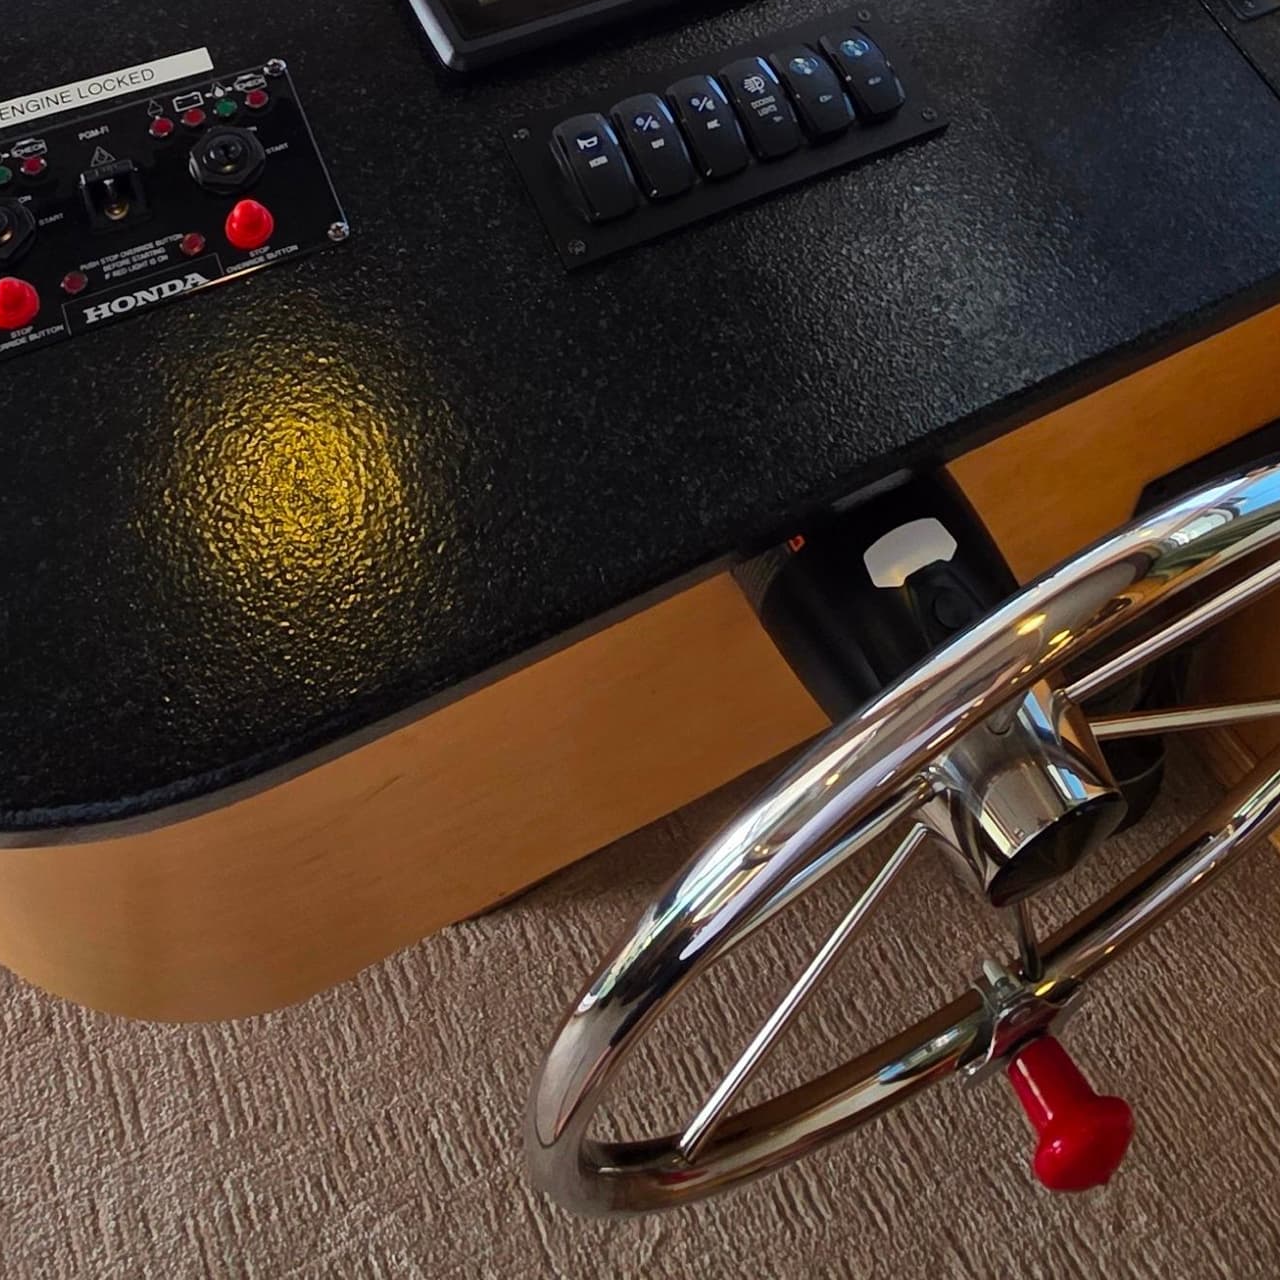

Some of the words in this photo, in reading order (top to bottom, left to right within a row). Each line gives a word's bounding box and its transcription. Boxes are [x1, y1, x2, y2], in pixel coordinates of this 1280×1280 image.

[77, 68, 155, 99] LOCKED
[249, 245, 271, 258] STOP
[266, 244, 299, 260] BUTTON
[83, 271, 210, 324] HONDA
[10, 325, 34, 339] STOP
[28, 323, 65, 342] BUTTON
